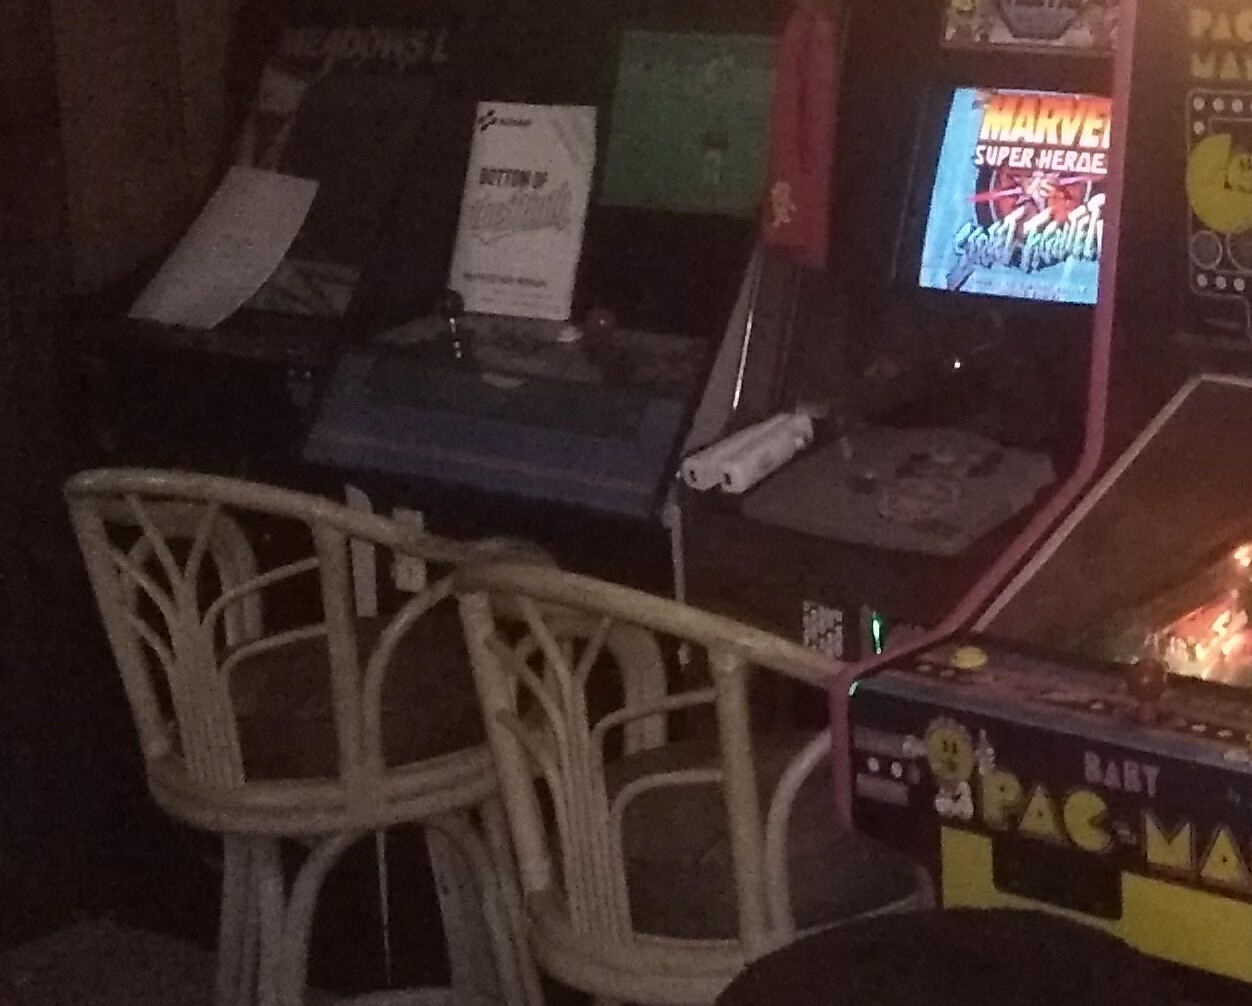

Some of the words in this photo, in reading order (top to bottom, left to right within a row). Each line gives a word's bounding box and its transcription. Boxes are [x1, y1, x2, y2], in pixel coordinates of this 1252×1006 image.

[974, 145, 1033, 169] SUPER
[1036, 150, 1108, 174] HEROE
[1084, 750, 1160, 796] BABY
